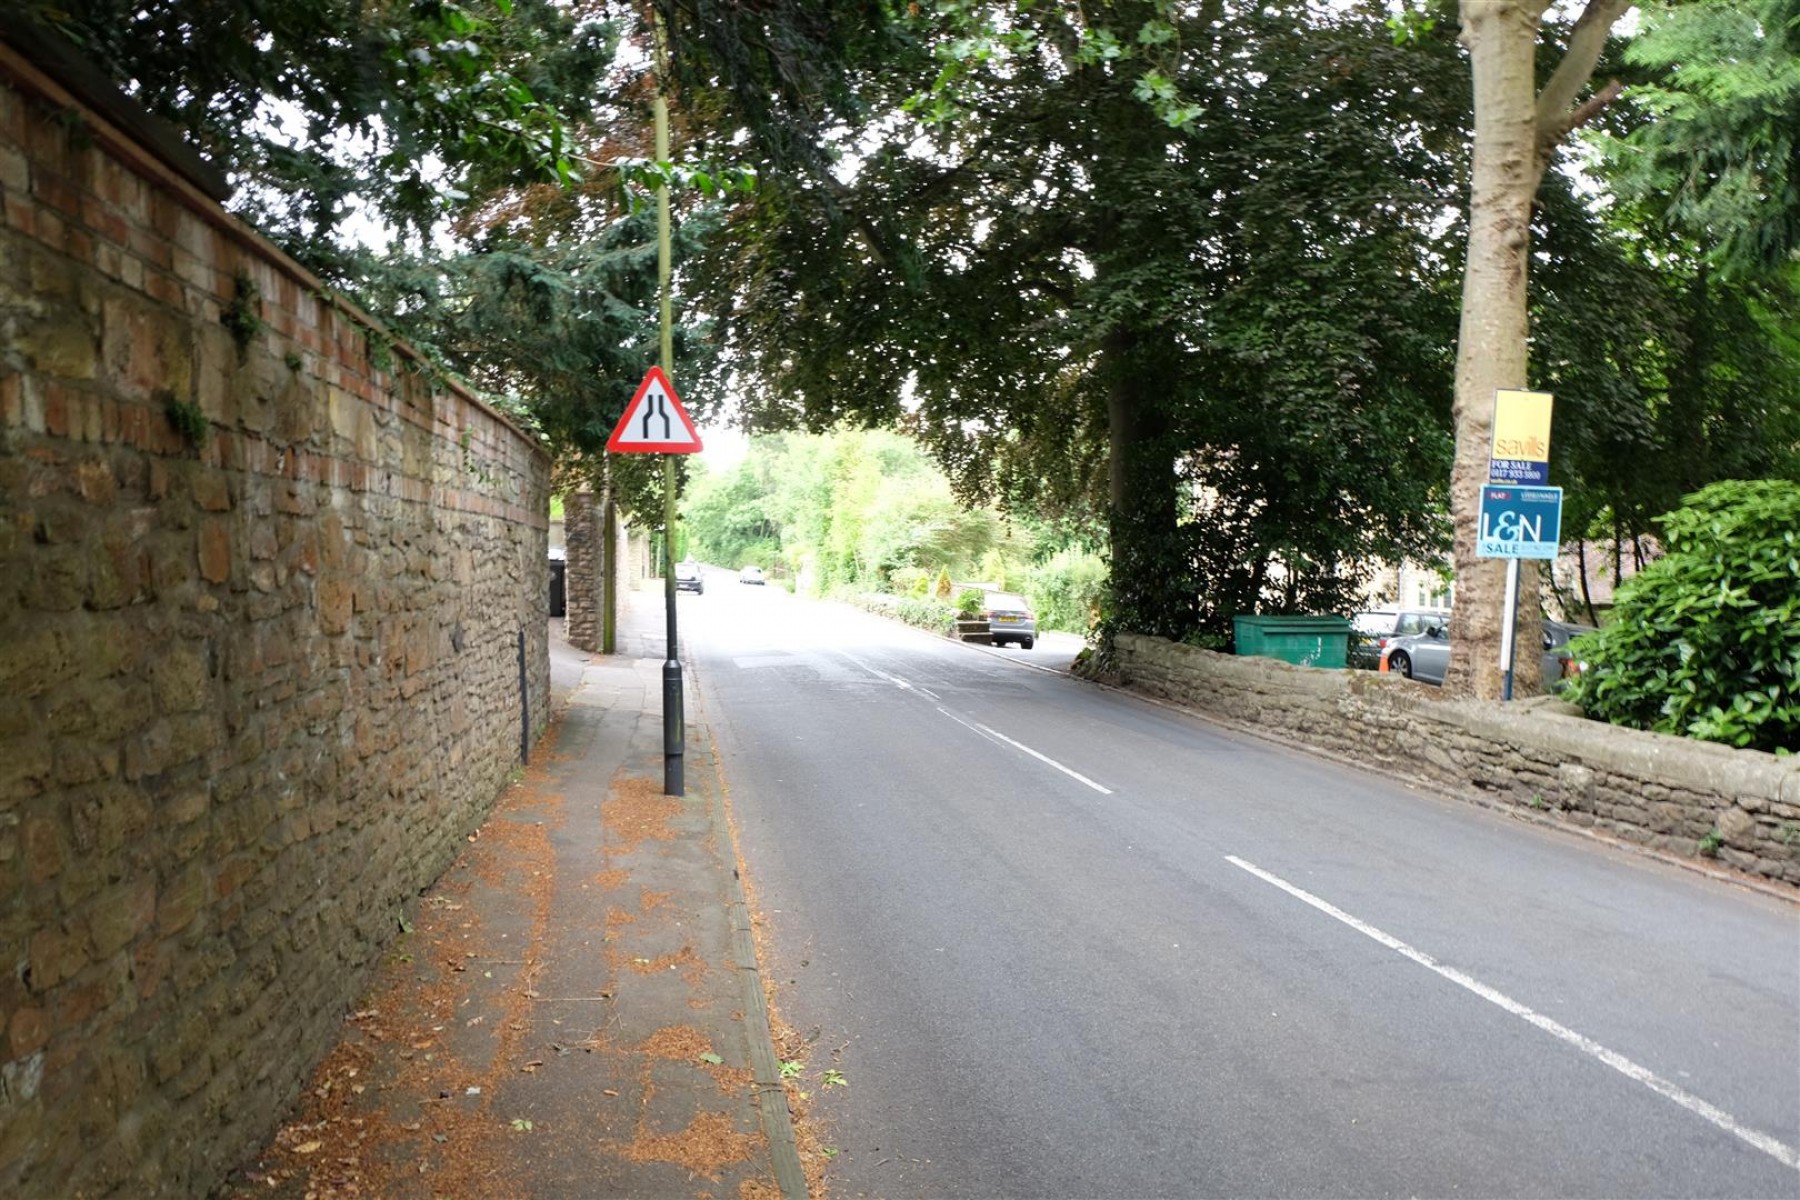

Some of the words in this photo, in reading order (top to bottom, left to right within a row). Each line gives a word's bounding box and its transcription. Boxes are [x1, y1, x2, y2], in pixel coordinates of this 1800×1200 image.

[1491, 460, 1510, 470] FOR
[1510, 462, 1532, 471] SALE
[1483, 511, 1541, 542] L&N
[1486, 544, 1519, 554] SALE
